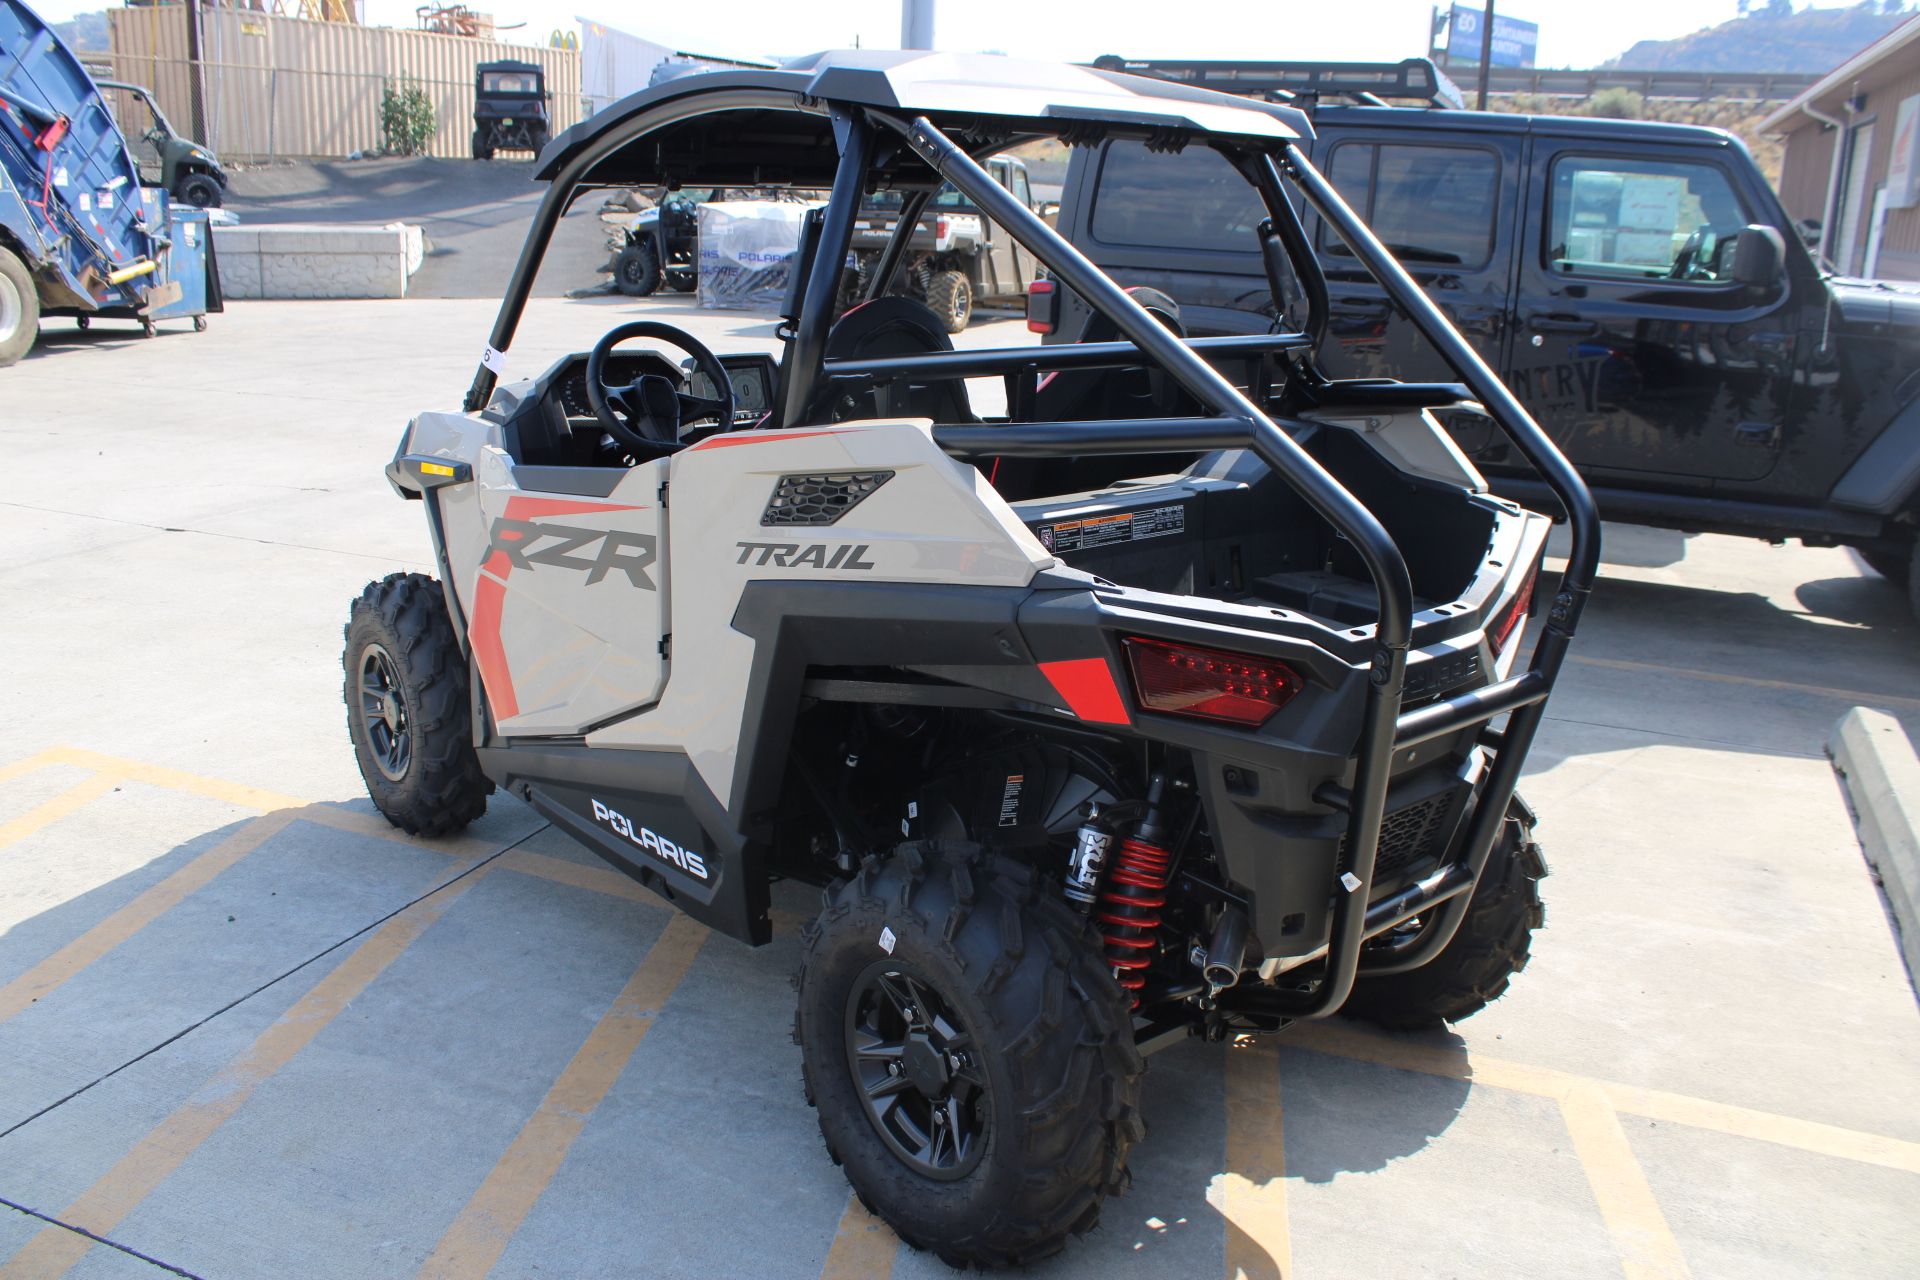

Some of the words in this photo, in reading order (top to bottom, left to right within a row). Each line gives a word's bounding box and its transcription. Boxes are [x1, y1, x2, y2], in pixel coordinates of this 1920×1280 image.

[742, 384, 750, 396] 0
[479, 517, 657, 592] RZR
[735, 541, 875, 571] TRAIL
[591, 798, 708, 880] POLARIS
[1077, 833, 1108, 887] FOX
